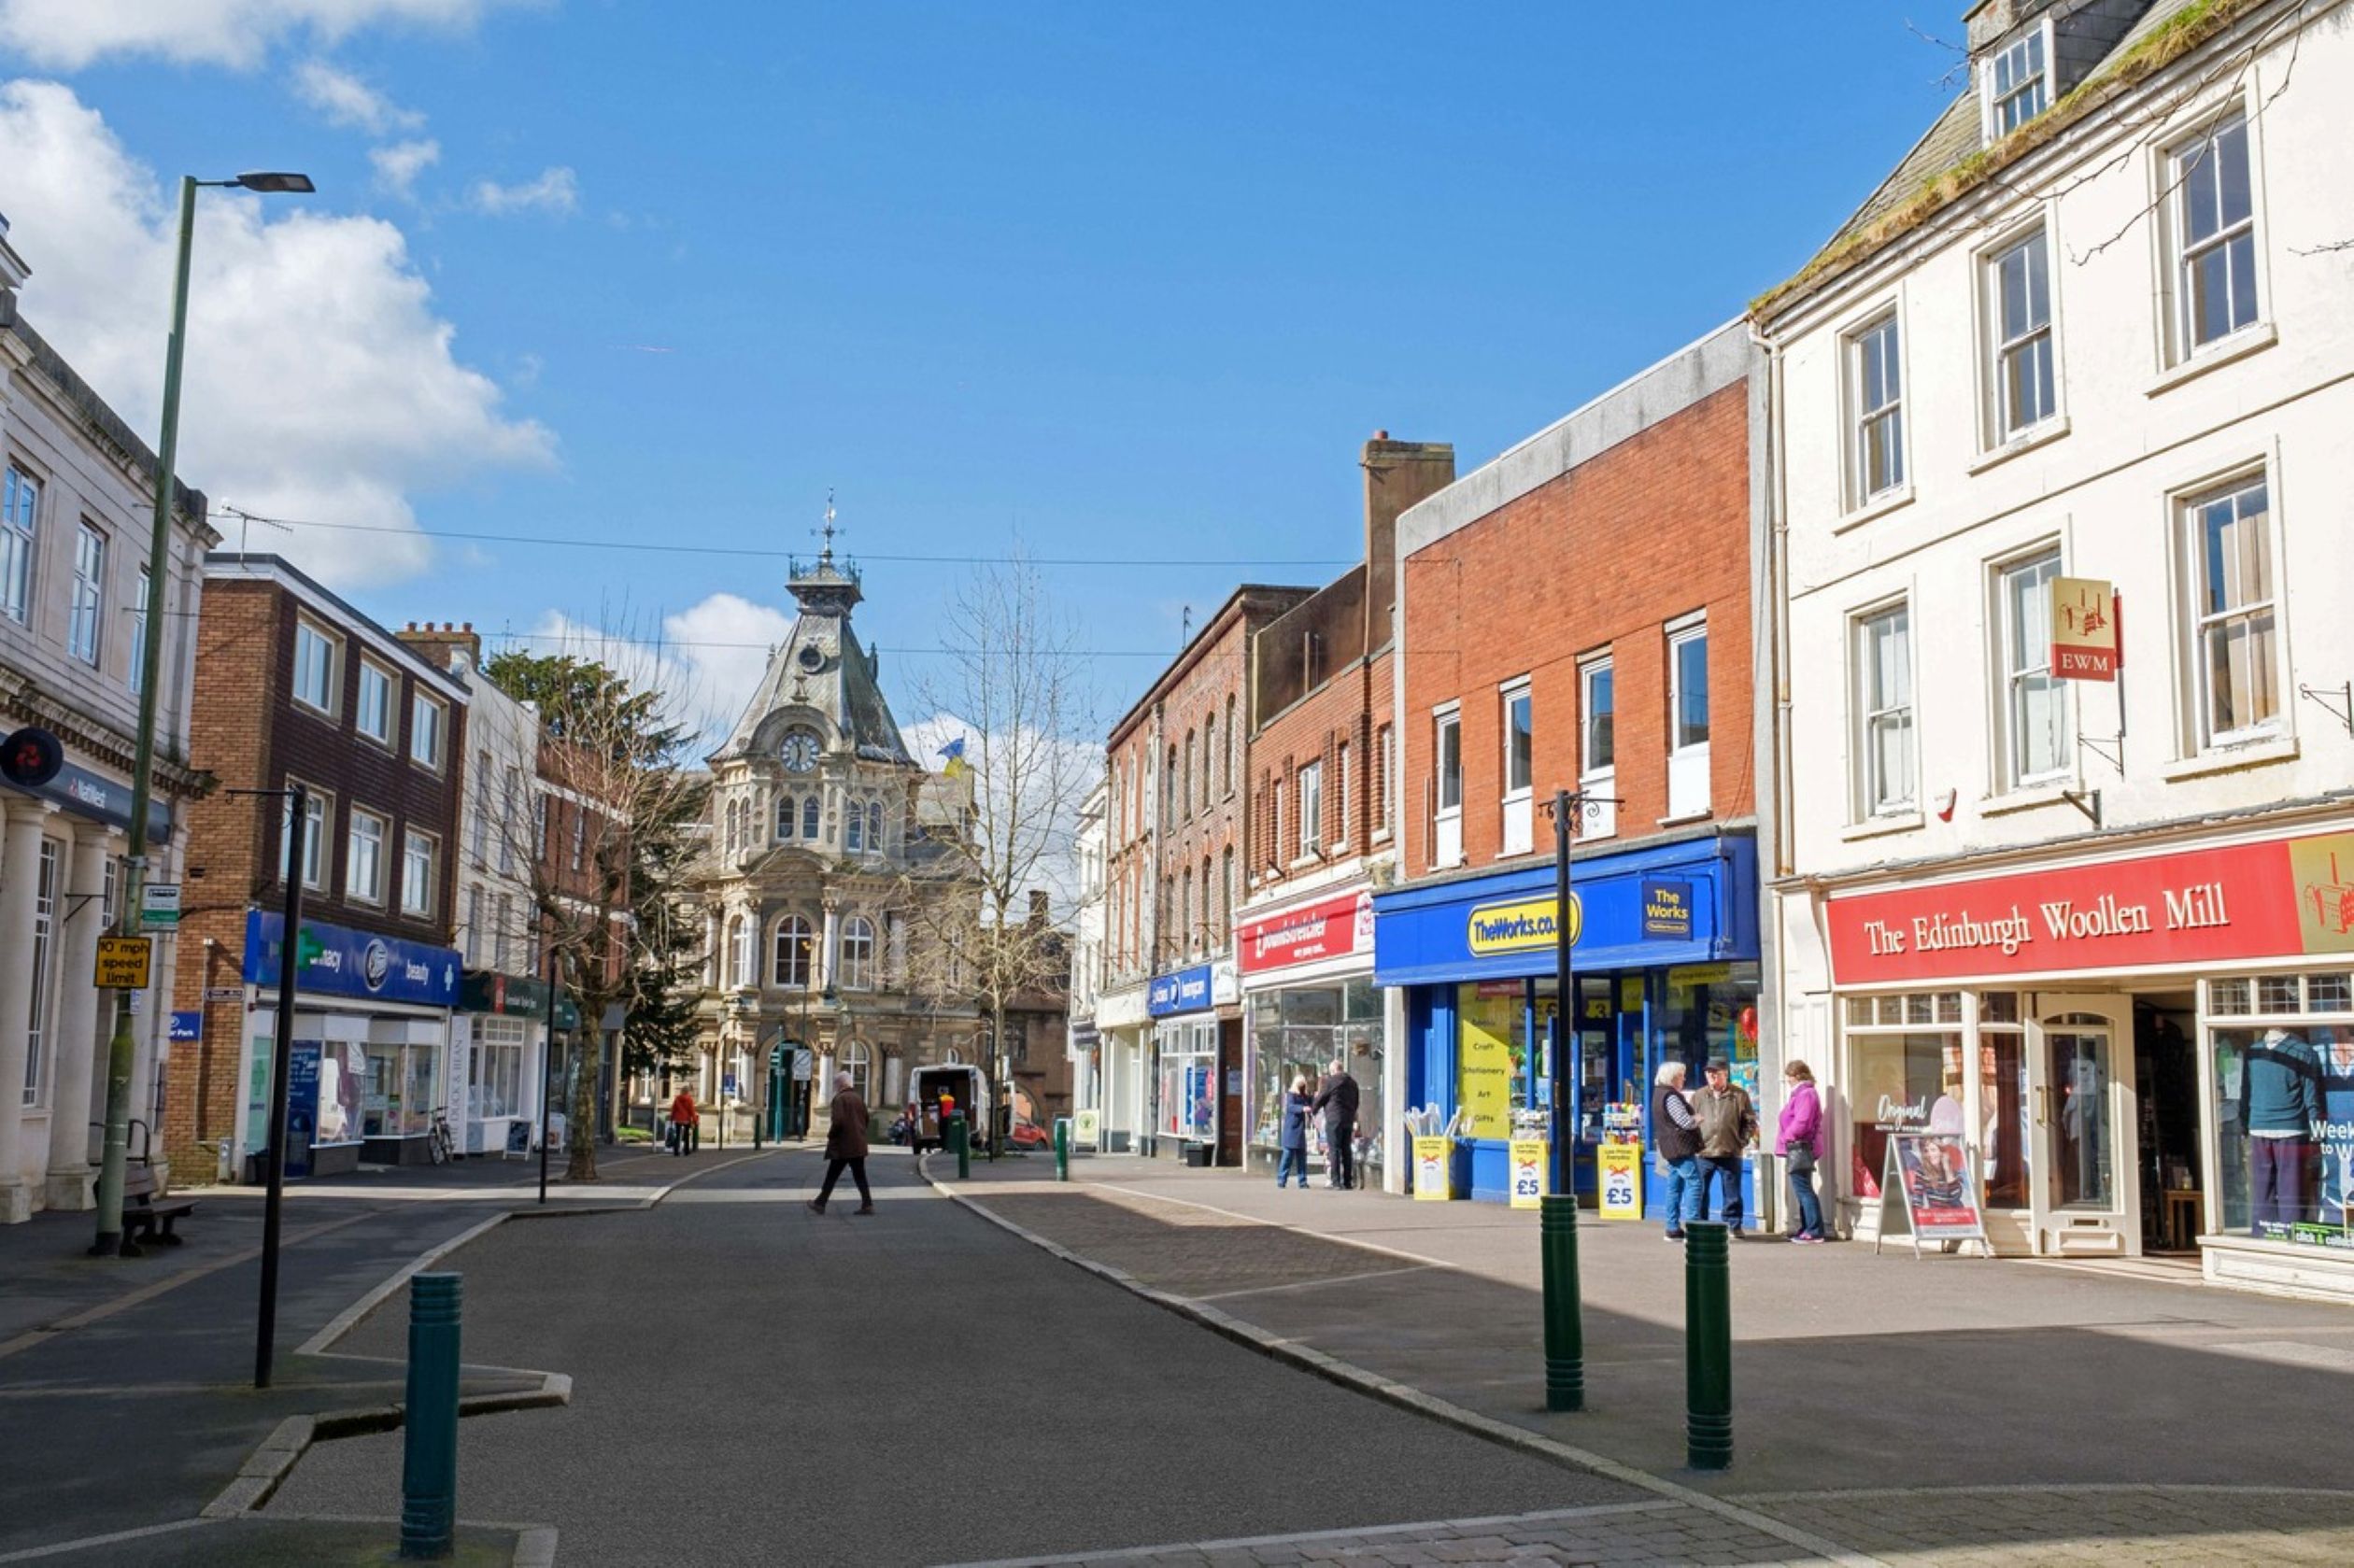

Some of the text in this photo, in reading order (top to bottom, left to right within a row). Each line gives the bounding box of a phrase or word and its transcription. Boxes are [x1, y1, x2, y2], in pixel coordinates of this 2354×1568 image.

[2062, 653, 2108, 671] EWM
[78, 779, 106, 809] NatWest
[1654, 889, 1680, 904] The
[1647, 904, 1689, 920] Works
[1864, 882, 2231, 955] The Edinburgh Woollen Mill
[1474, 913, 1560, 942] TheWorks.co.
[101, 940, 149, 954] 10 mph
[103, 957, 144, 970] speed
[106, 972, 136, 984] limit
[1472, 1042, 1495, 1052] Craft
[1463, 1067, 1506, 1076] Stationery
[1474, 1114, 1495, 1123] Gifts
[1879, 1095, 1927, 1128] Original
[2320, 1143, 2334, 1155] to
[1517, 1180, 1539, 1195] £5
[1606, 1187, 1633, 1205] £5
